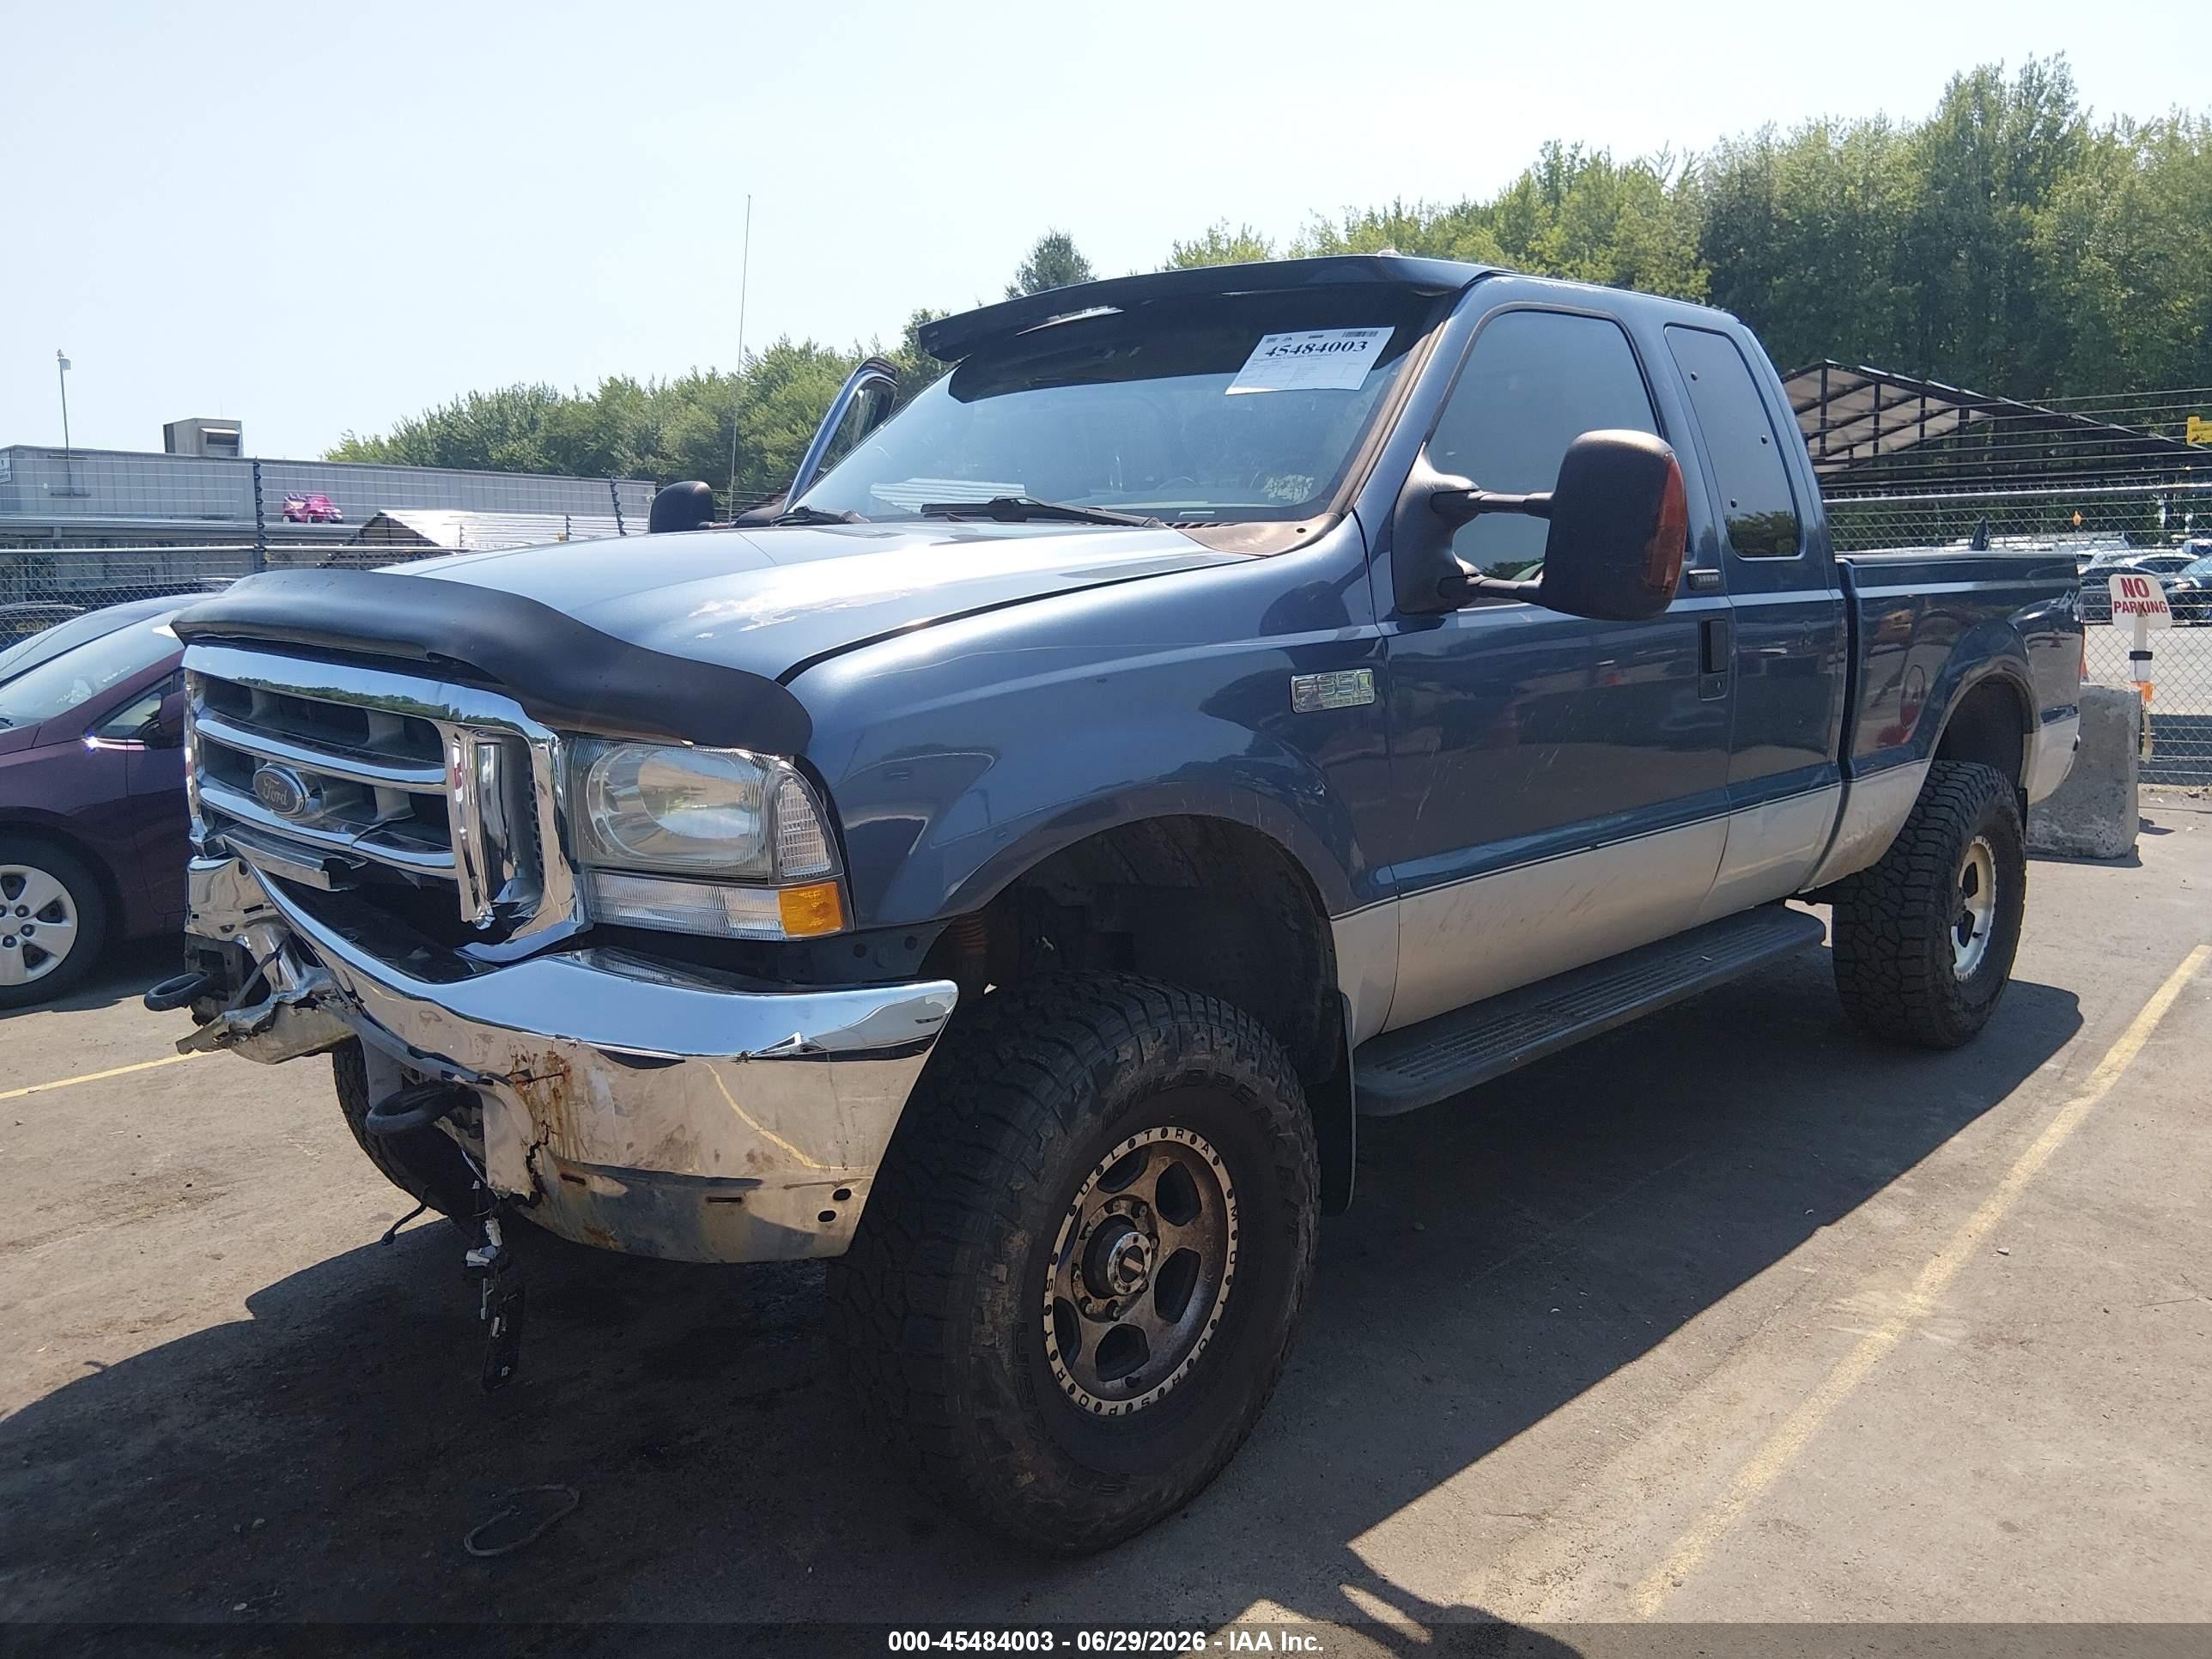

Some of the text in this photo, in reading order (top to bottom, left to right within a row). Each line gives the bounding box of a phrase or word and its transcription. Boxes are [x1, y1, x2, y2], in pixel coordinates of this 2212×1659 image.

[1264, 340, 1369, 358] 45484003
[2120, 577, 2150, 599] NO
[2113, 600, 2169, 614] PARKING
[261, 776, 289, 806] Ford
